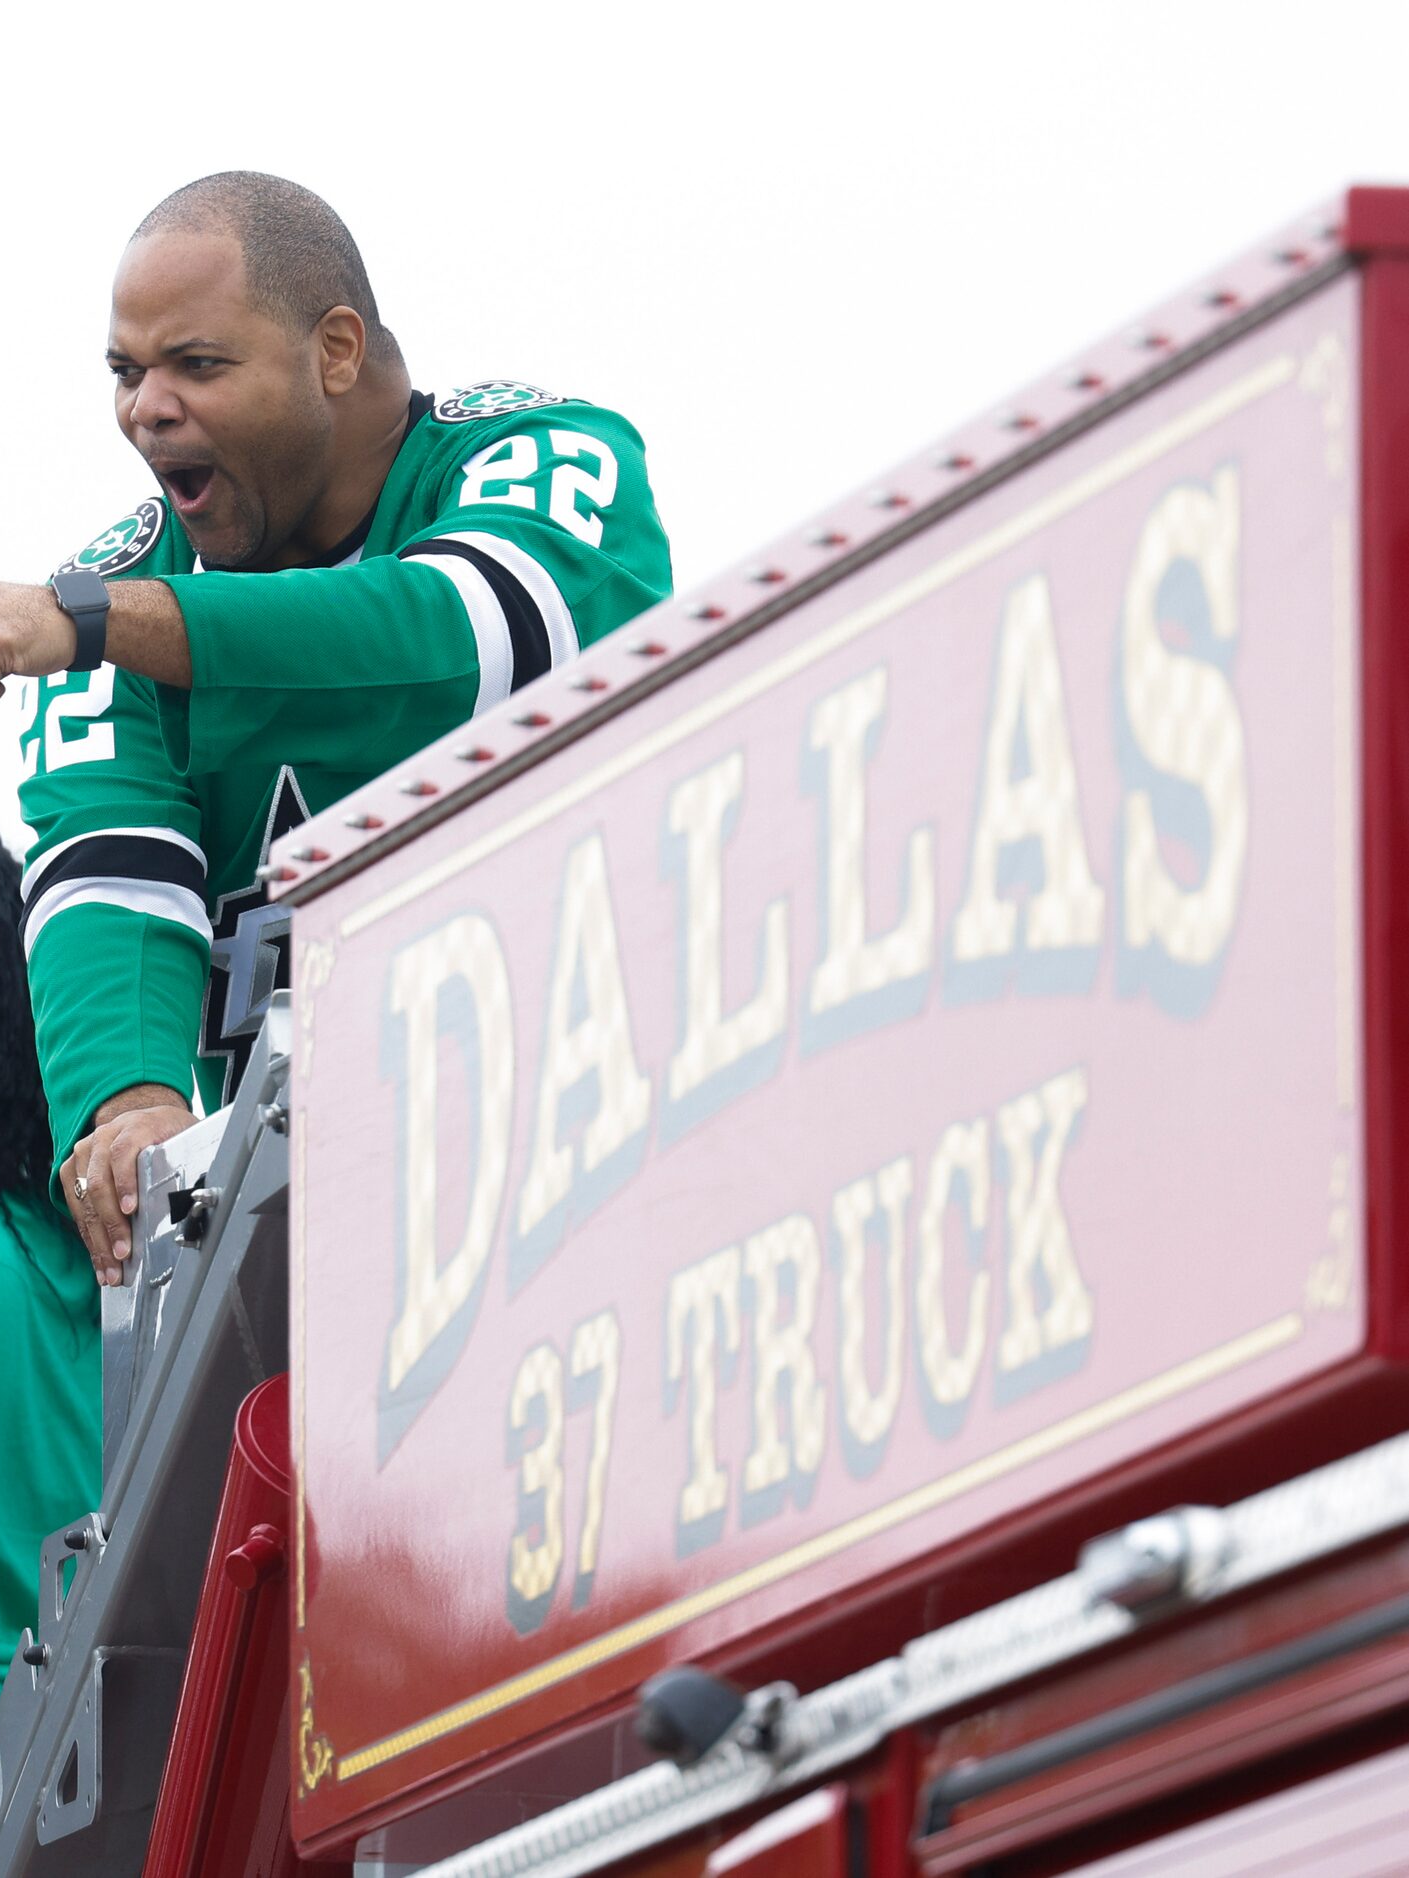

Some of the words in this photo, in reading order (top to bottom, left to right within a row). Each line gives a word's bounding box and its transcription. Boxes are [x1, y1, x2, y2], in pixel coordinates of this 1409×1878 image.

[458, 429, 618, 549] 22
[380, 457, 1248, 1445] DALLAS
[506, 1304, 621, 1622] 37
[665, 1062, 1094, 1545] TRUCK
